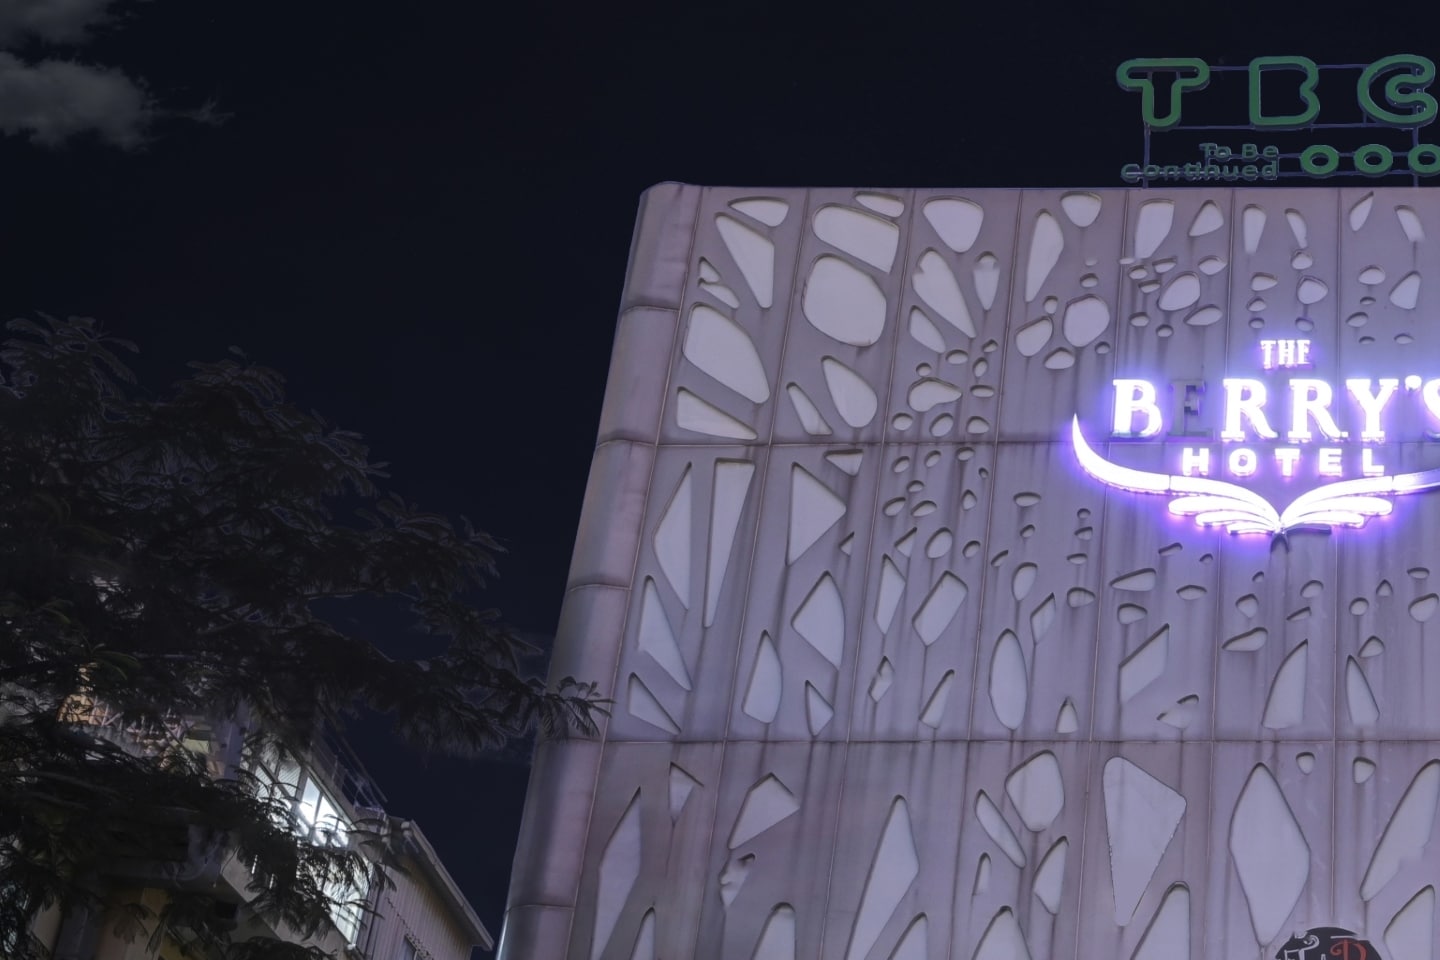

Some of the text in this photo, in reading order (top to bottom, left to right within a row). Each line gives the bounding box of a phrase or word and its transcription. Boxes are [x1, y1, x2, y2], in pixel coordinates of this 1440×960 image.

[1199, 142, 1279, 159] To Be
[1260, 339, 1311, 368] THE
[1182, 448, 1385, 476] HOTEL
